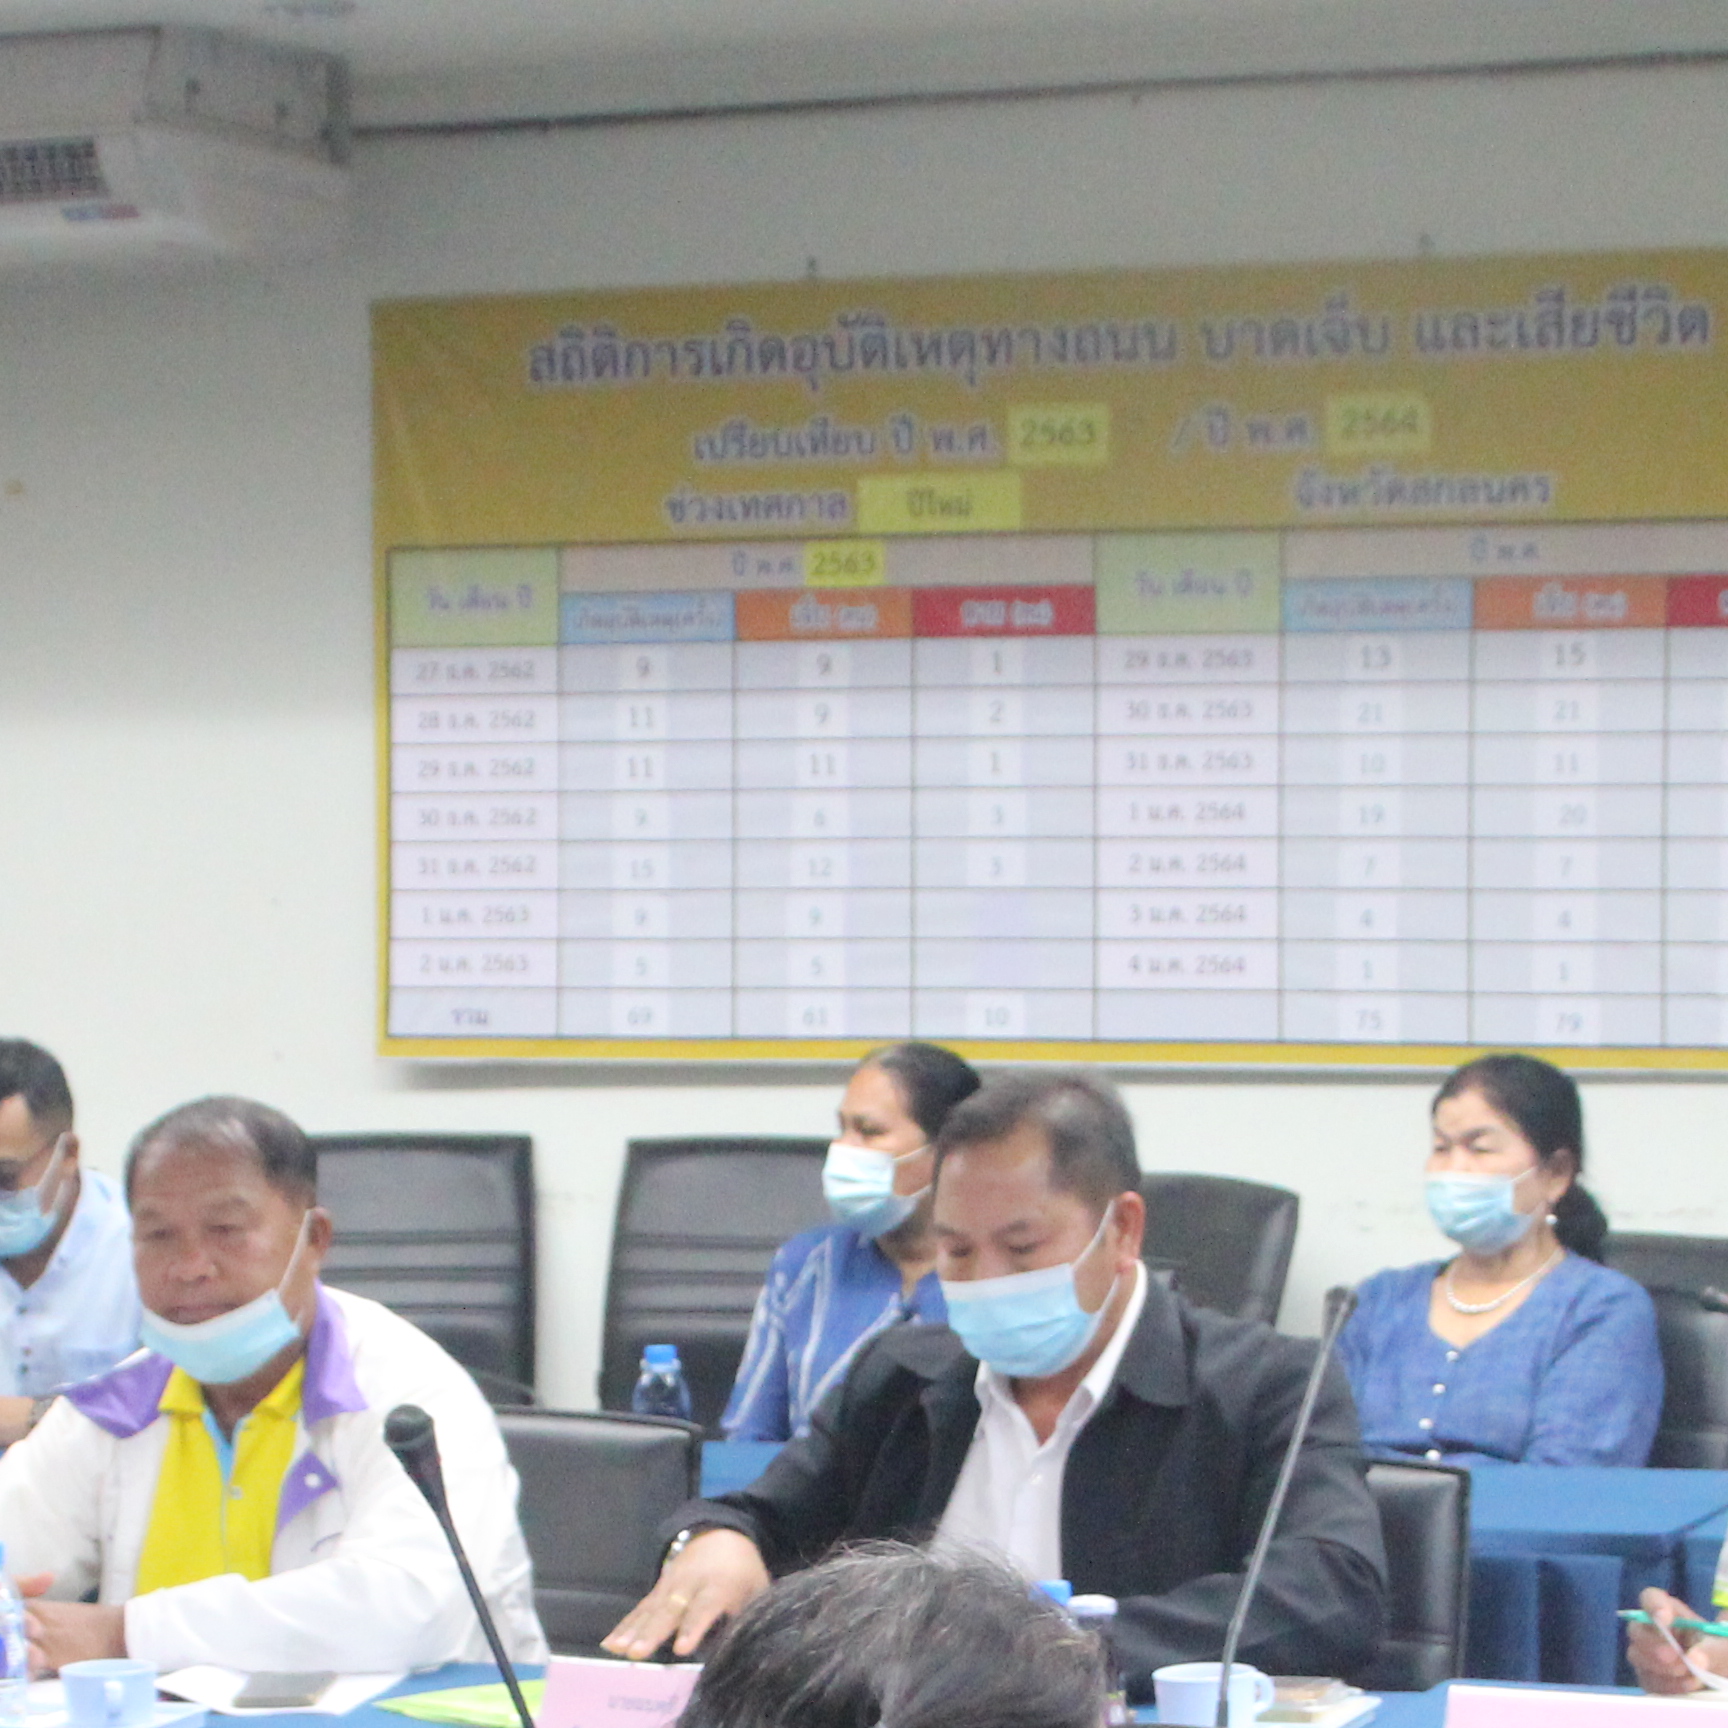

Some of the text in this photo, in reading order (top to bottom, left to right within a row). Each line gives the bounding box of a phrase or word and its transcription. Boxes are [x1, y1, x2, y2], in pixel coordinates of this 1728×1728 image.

[530, 284, 1710, 392] สถิติการเกิดอุบัติเหตุทางถนน บาดเจ็บ และเสียชีวิต
